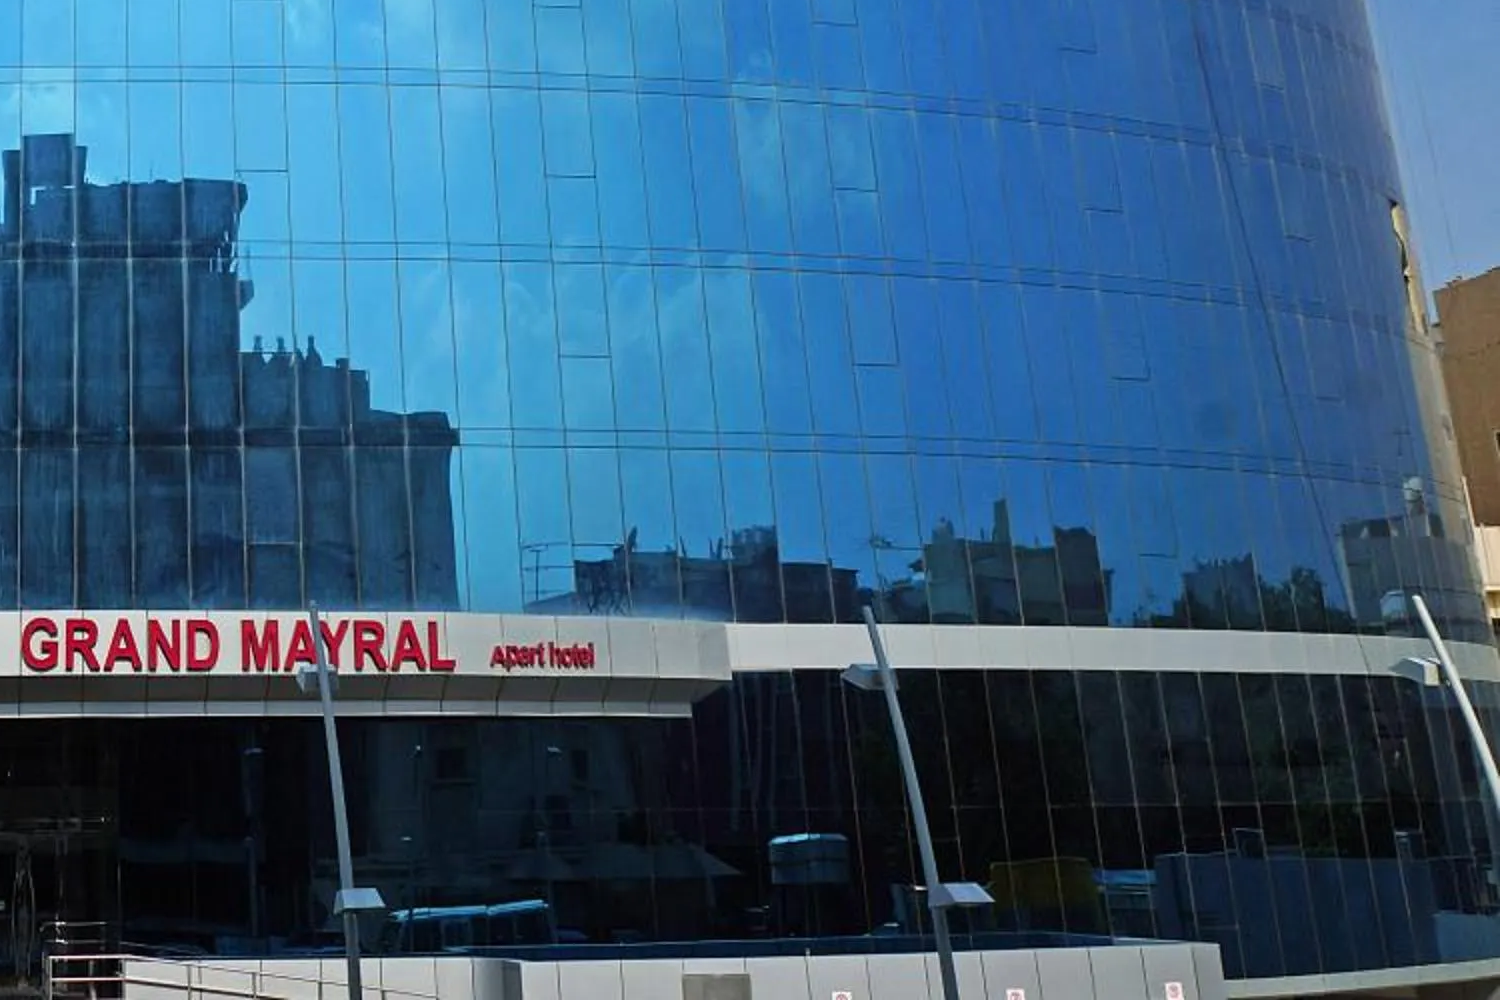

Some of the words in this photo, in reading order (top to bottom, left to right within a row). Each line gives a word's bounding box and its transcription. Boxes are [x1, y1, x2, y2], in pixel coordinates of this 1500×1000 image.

[21, 616, 221, 673] GRAND
[240, 618, 457, 673] MAYRAL
[547, 641, 595, 669] hotel
